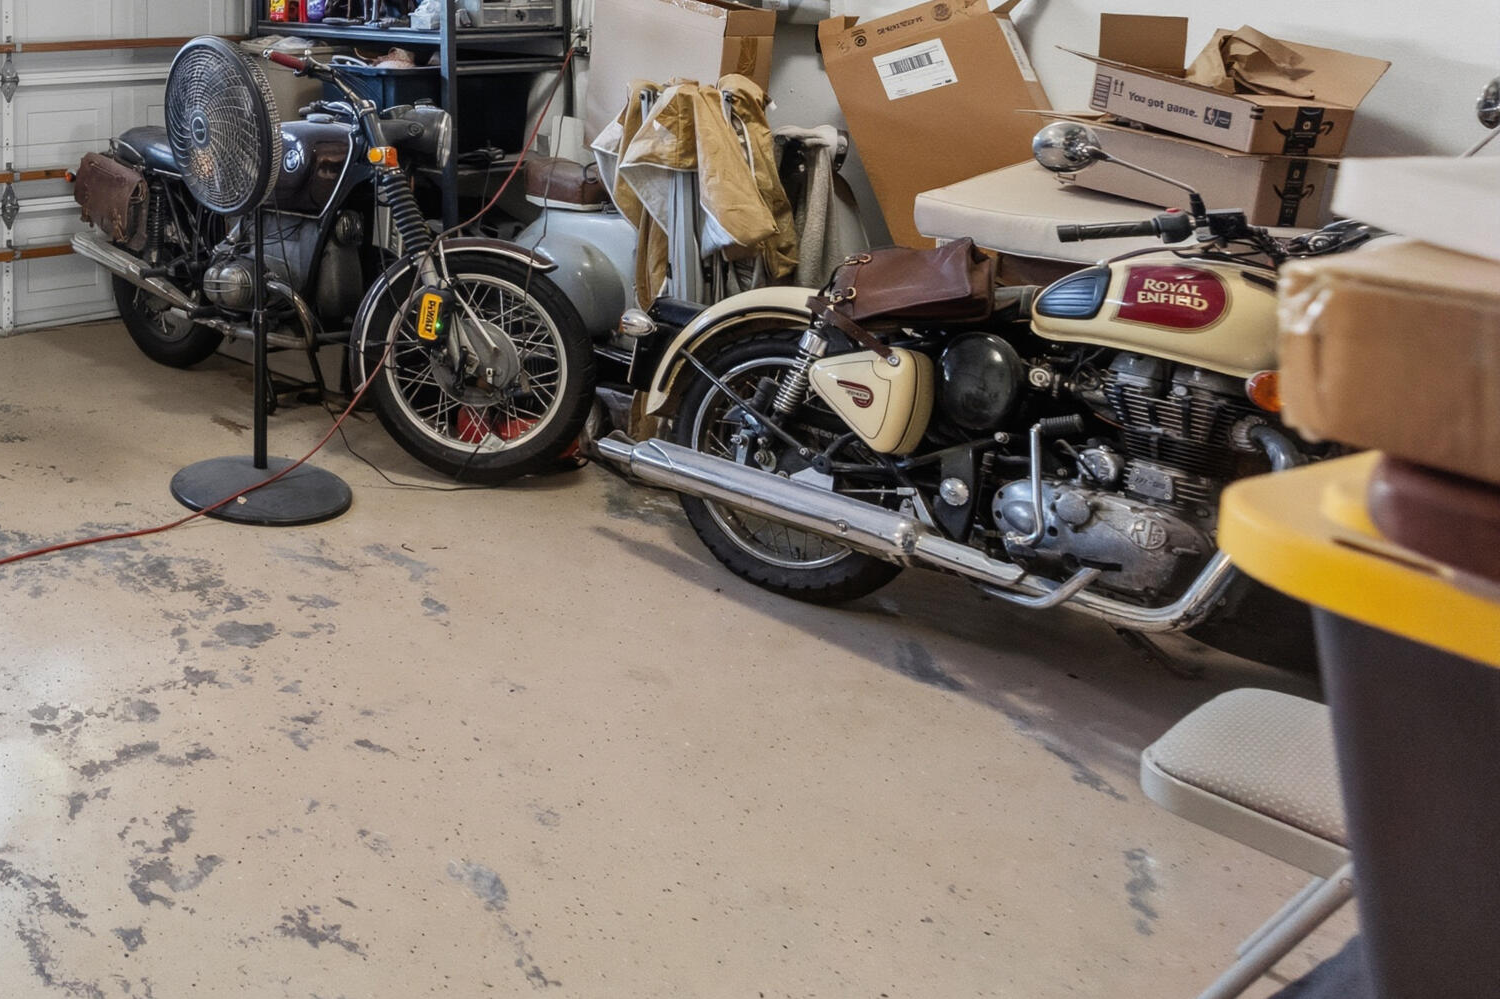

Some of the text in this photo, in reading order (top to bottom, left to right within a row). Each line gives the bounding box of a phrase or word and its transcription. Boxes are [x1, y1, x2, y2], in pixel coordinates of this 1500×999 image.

[1128, 91, 1199, 118] You got game.
[1143, 278, 1202, 296] ROYAL
[1137, 291, 1209, 311] ENFIELD
